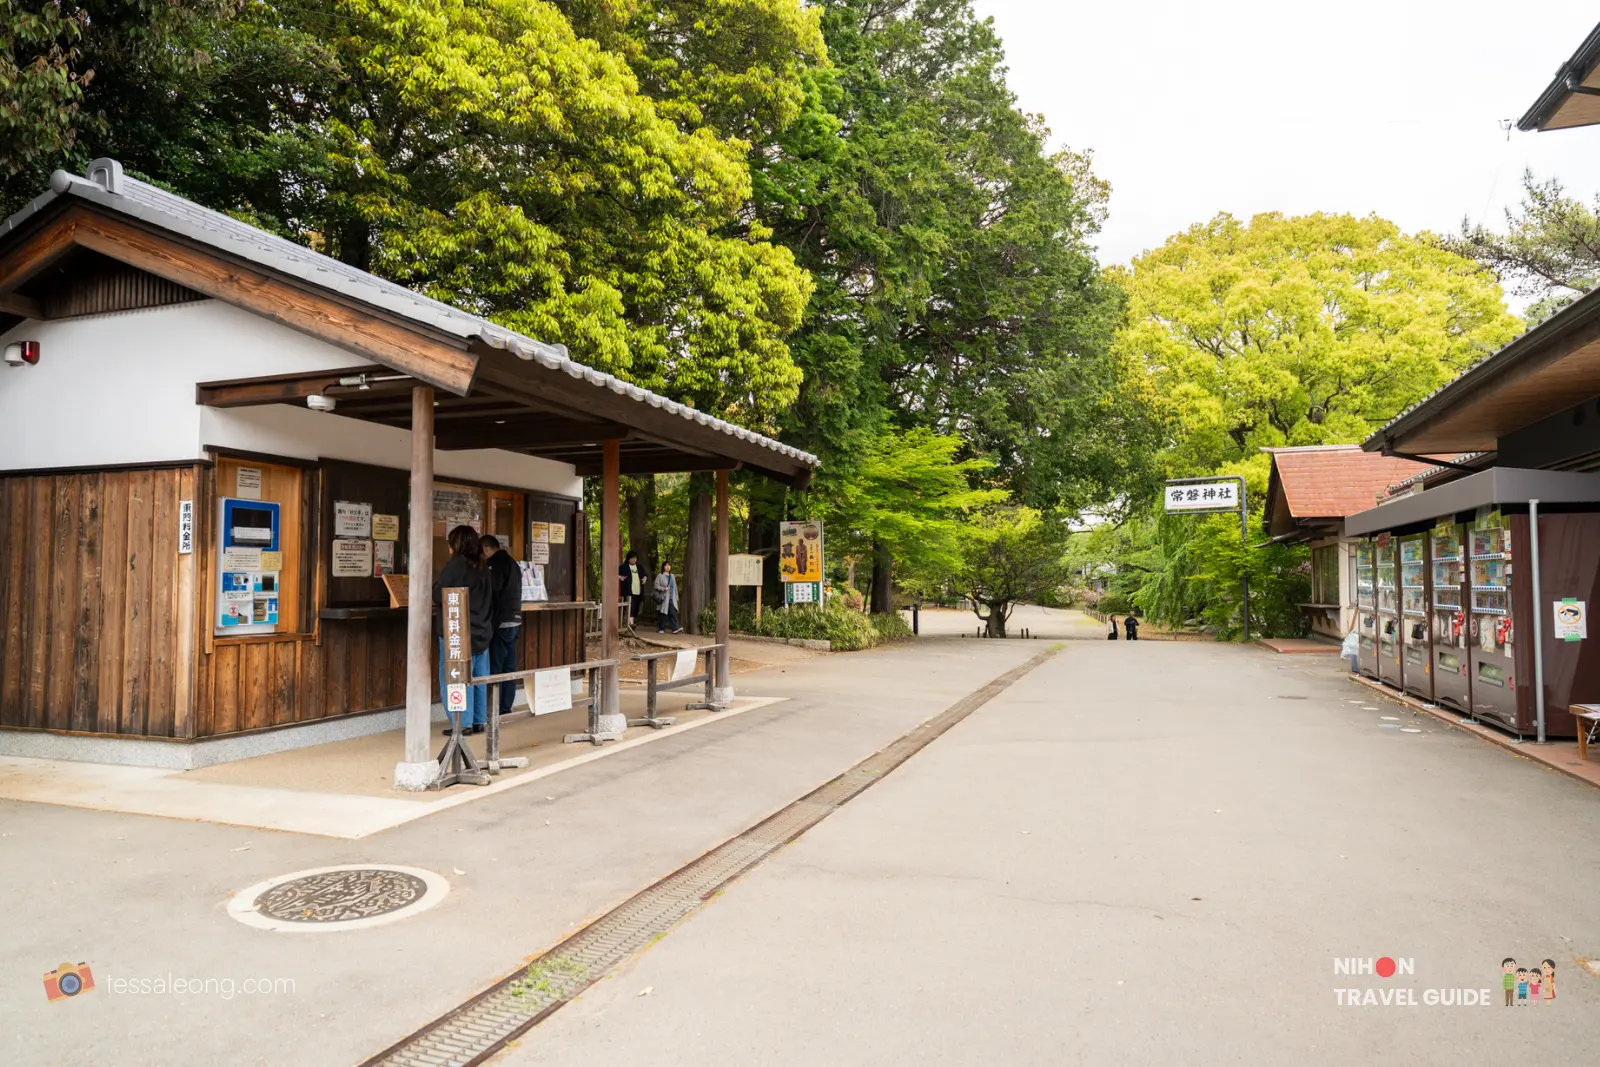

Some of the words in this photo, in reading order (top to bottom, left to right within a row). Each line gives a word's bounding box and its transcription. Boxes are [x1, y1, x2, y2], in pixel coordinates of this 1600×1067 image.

[1170, 487, 1232, 502] 常磐神社
[447, 592, 461, 660] 東門料金所
